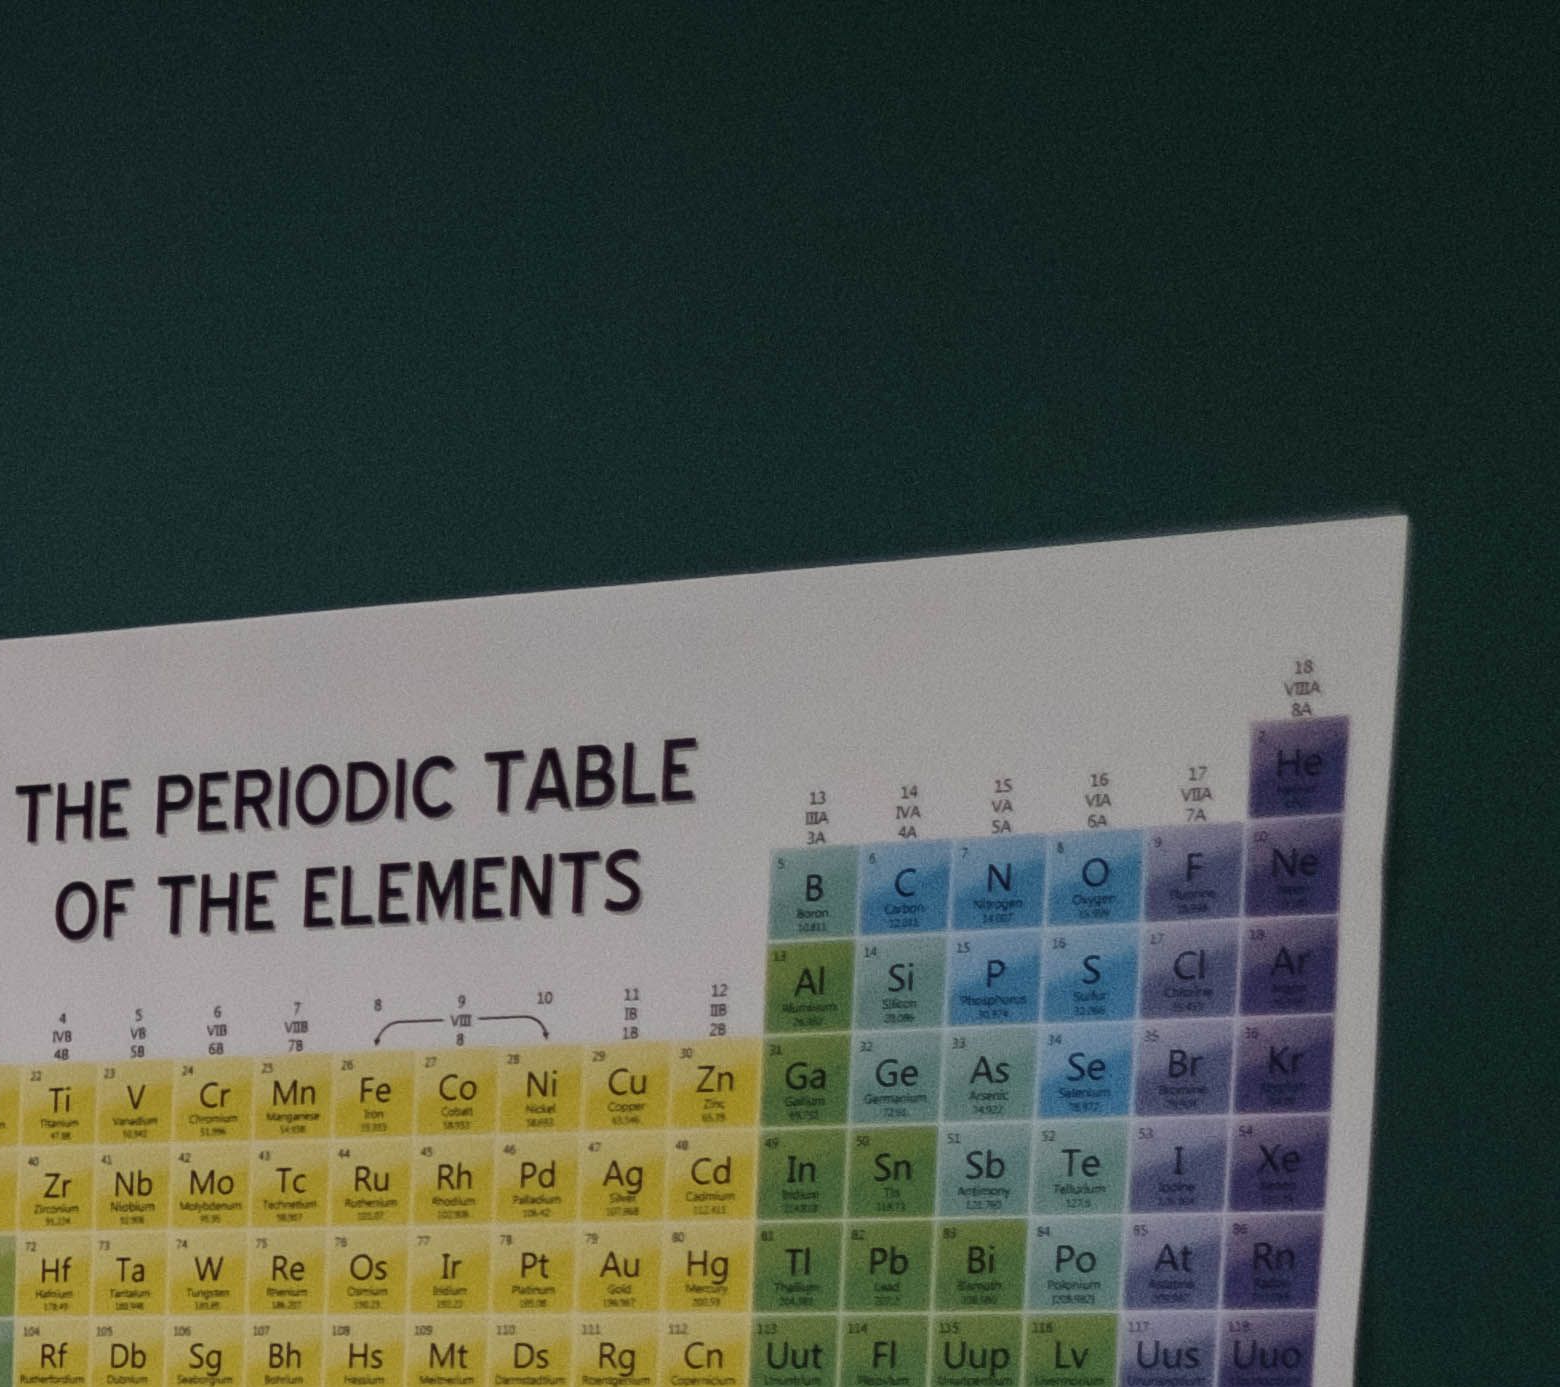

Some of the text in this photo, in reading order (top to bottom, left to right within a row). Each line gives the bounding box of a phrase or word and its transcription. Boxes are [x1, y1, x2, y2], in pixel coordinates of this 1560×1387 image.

[1294, 660, 1313, 675] 18
[1291, 703, 1312, 717] 8A
[994, 779, 1012, 794] 15
[1091, 773, 1109, 787] 16
[1189, 767, 1207, 782] 17
[16, 738, 698, 844] THE PERIODIC TABLE
[810, 792, 826, 806] 13
[902, 785, 918, 800] 14
[1181, 787, 1212, 802] VIIA
[807, 831, 826, 845] 3A
[987, 864, 1011, 893] N
[1082, 858, 1109, 887] O
[1186, 853, 1203, 882] F
[55, 849, 643, 940] OF THE ELEMENTS
[805, 875, 824, 901] B
[894, 868, 916, 897] C
[986, 960, 1005, 988] P
[1082, 956, 1101, 985] S
[1173, 950, 1205, 980] Cl
[711, 984, 728, 998] 12
[794, 968, 825, 997] Al
[889, 964, 914, 994] Si
[458, 995, 465, 1009] 9
[537, 992, 553, 1005] 10
[624, 988, 639, 1002] 11
[293, 1002, 300, 1015] 7
[54, 1048, 69, 1060] 4B
[1067, 1052, 1106, 1081] Se
[1168, 1049, 1203, 1078] Br
[608, 1069, 647, 1095] Cu
[696, 1066, 734, 1093] Zn
[785, 1061, 827, 1091] Ga
[875, 1058, 919, 1088] Ge
[970, 1056, 1009, 1084] As
[127, 1085, 146, 1110] V
[200, 1081, 231, 1109] Cr
[272, 1080, 315, 1105] Mn
[360, 1077, 391, 1104] Fe
[439, 1075, 477, 1101] Co
[527, 1071, 557, 1098] Ni
[49, 1086, 71, 1113] Ti
[691, 1157, 731, 1185] Cd
[788, 1156, 816, 1184] In
[875, 1154, 911, 1182] Sn
[966, 1152, 1005, 1180] Sb
[1062, 1148, 1101, 1177] Te
[1173, 1146, 1186, 1175] I
[44, 1173, 72, 1198] Zr
[115, 1172, 152, 1197] Nb
[190, 1170, 234, 1196] Mo
[277, 1168, 306, 1194] Tc
[354, 1166, 389, 1192] Ru
[437, 1164, 472, 1190] Rh
[521, 1162, 556, 1188] Pd
[603, 1160, 644, 1195] Ag
[41, 1258, 72, 1283] Hf
[116, 1258, 145, 1283] Ta
[195, 1257, 223, 1281] W
[272, 1256, 305, 1282] Re
[350, 1255, 387, 1281] Os
[442, 1254, 461, 1279] Ir
[521, 1253, 549, 1279] Pt
[600, 1252, 640, 1278] Au
[688, 1251, 729, 1285] Hg
[786, 1248, 811, 1276] Tl
[869, 1247, 908, 1276] Pb
[968, 1245, 995, 1275] Bi
[1056, 1244, 1096, 1274] Po
